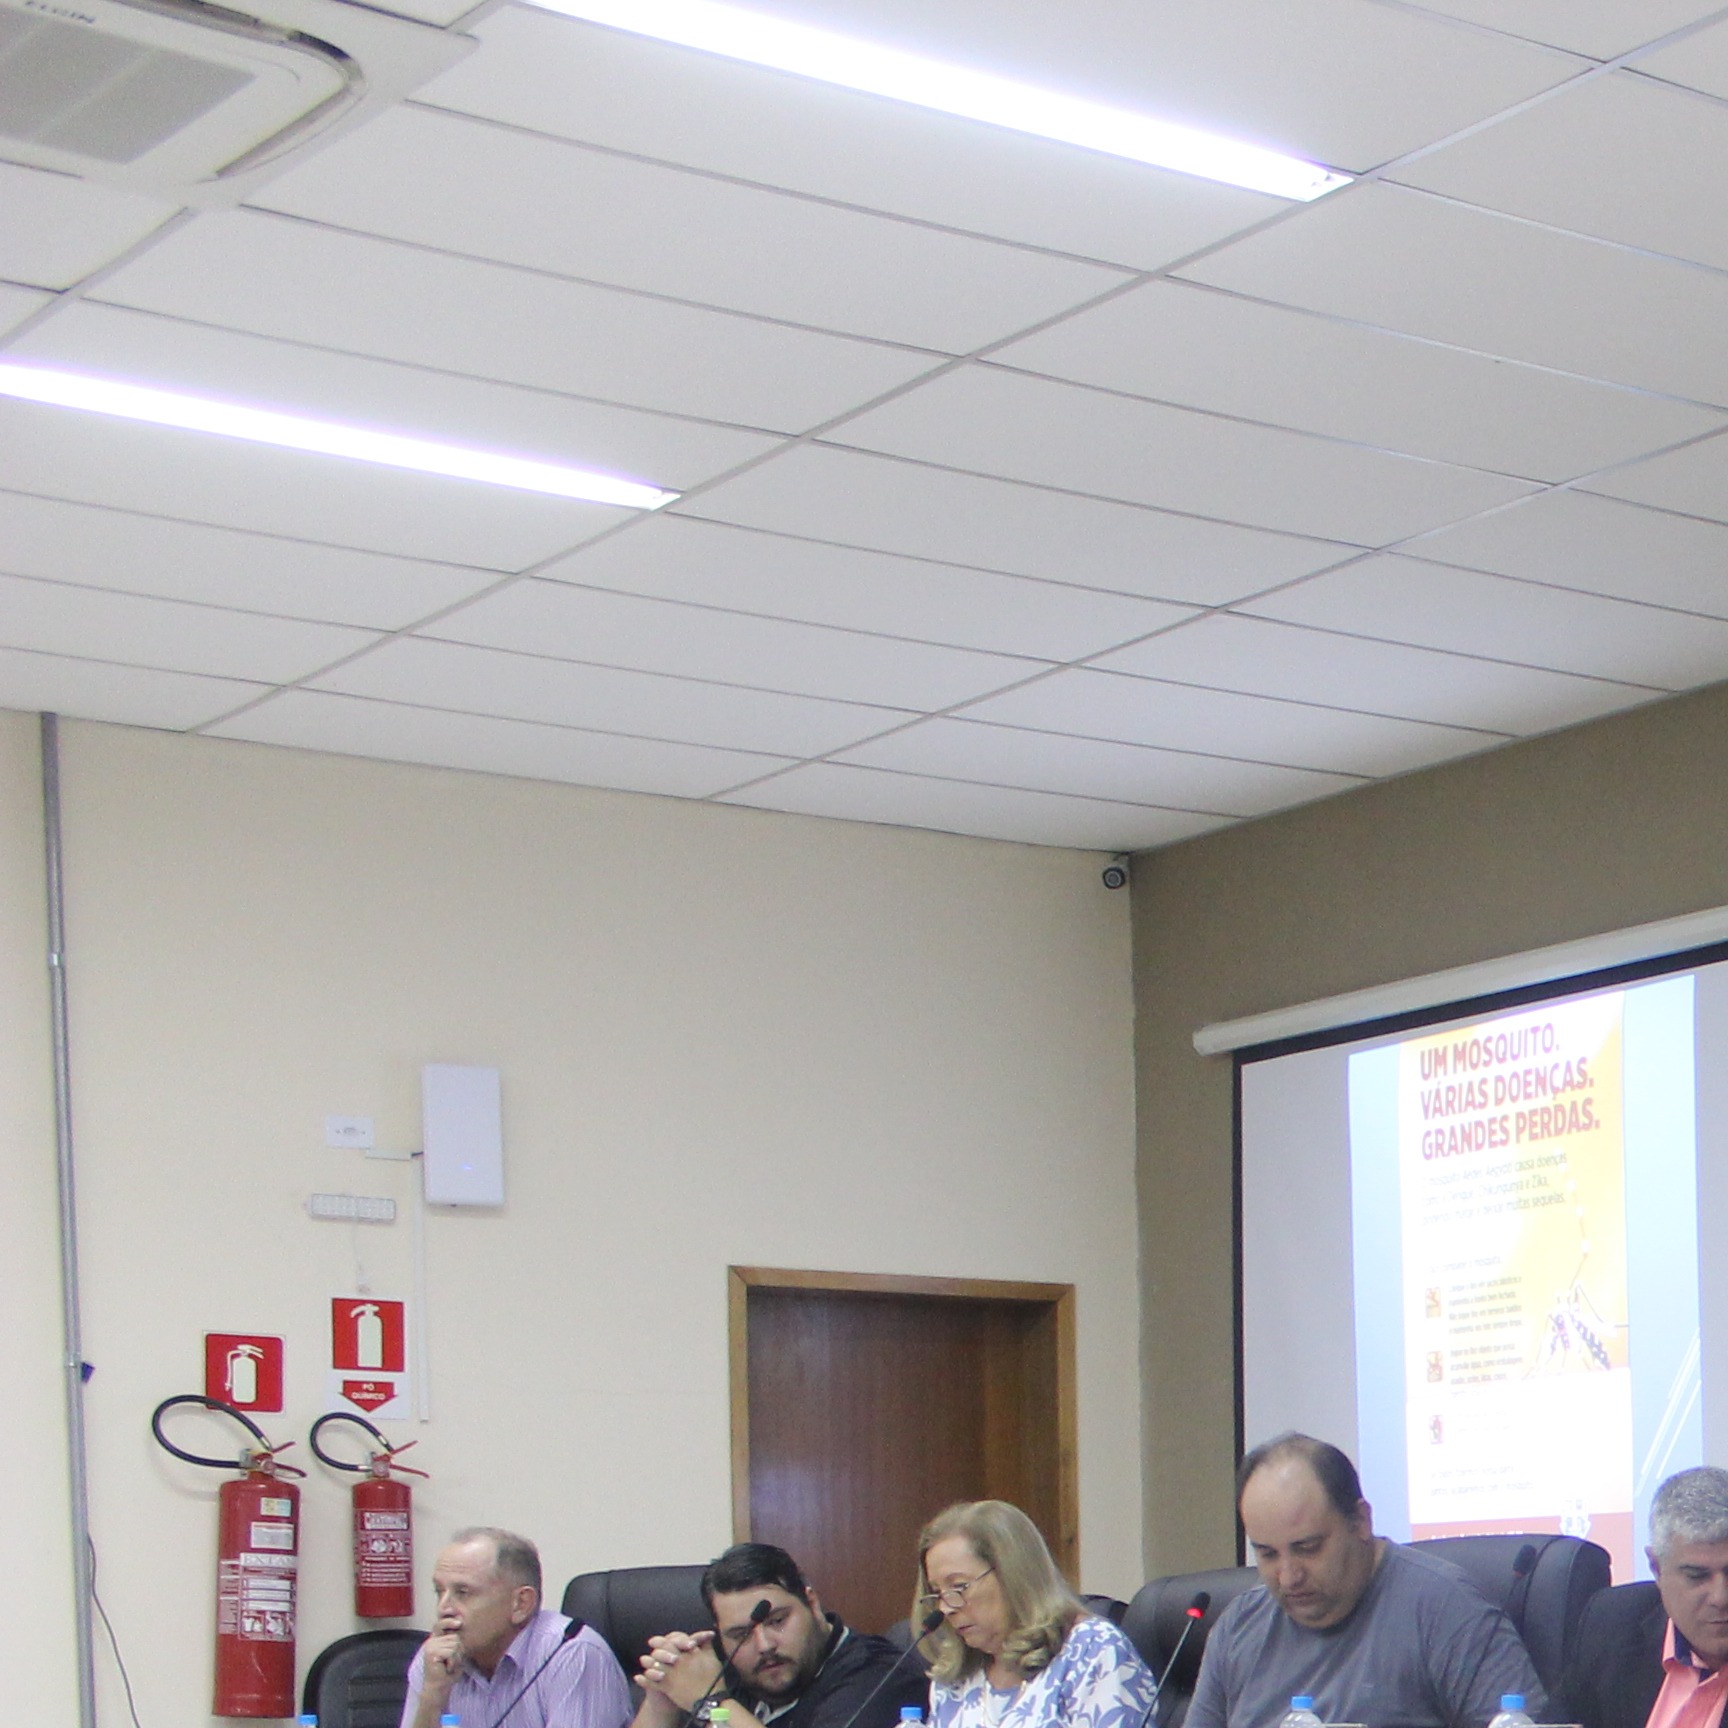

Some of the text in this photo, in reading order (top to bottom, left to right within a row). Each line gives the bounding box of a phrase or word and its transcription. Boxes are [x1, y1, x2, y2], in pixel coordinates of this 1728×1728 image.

[1420, 1022, 1560, 1081] UM MOSQUITO.
[1420, 1056, 1594, 1120] VÁRIAS DOENÇAS.
[1422, 1097, 1600, 1160] GRANDES PERDAS.
